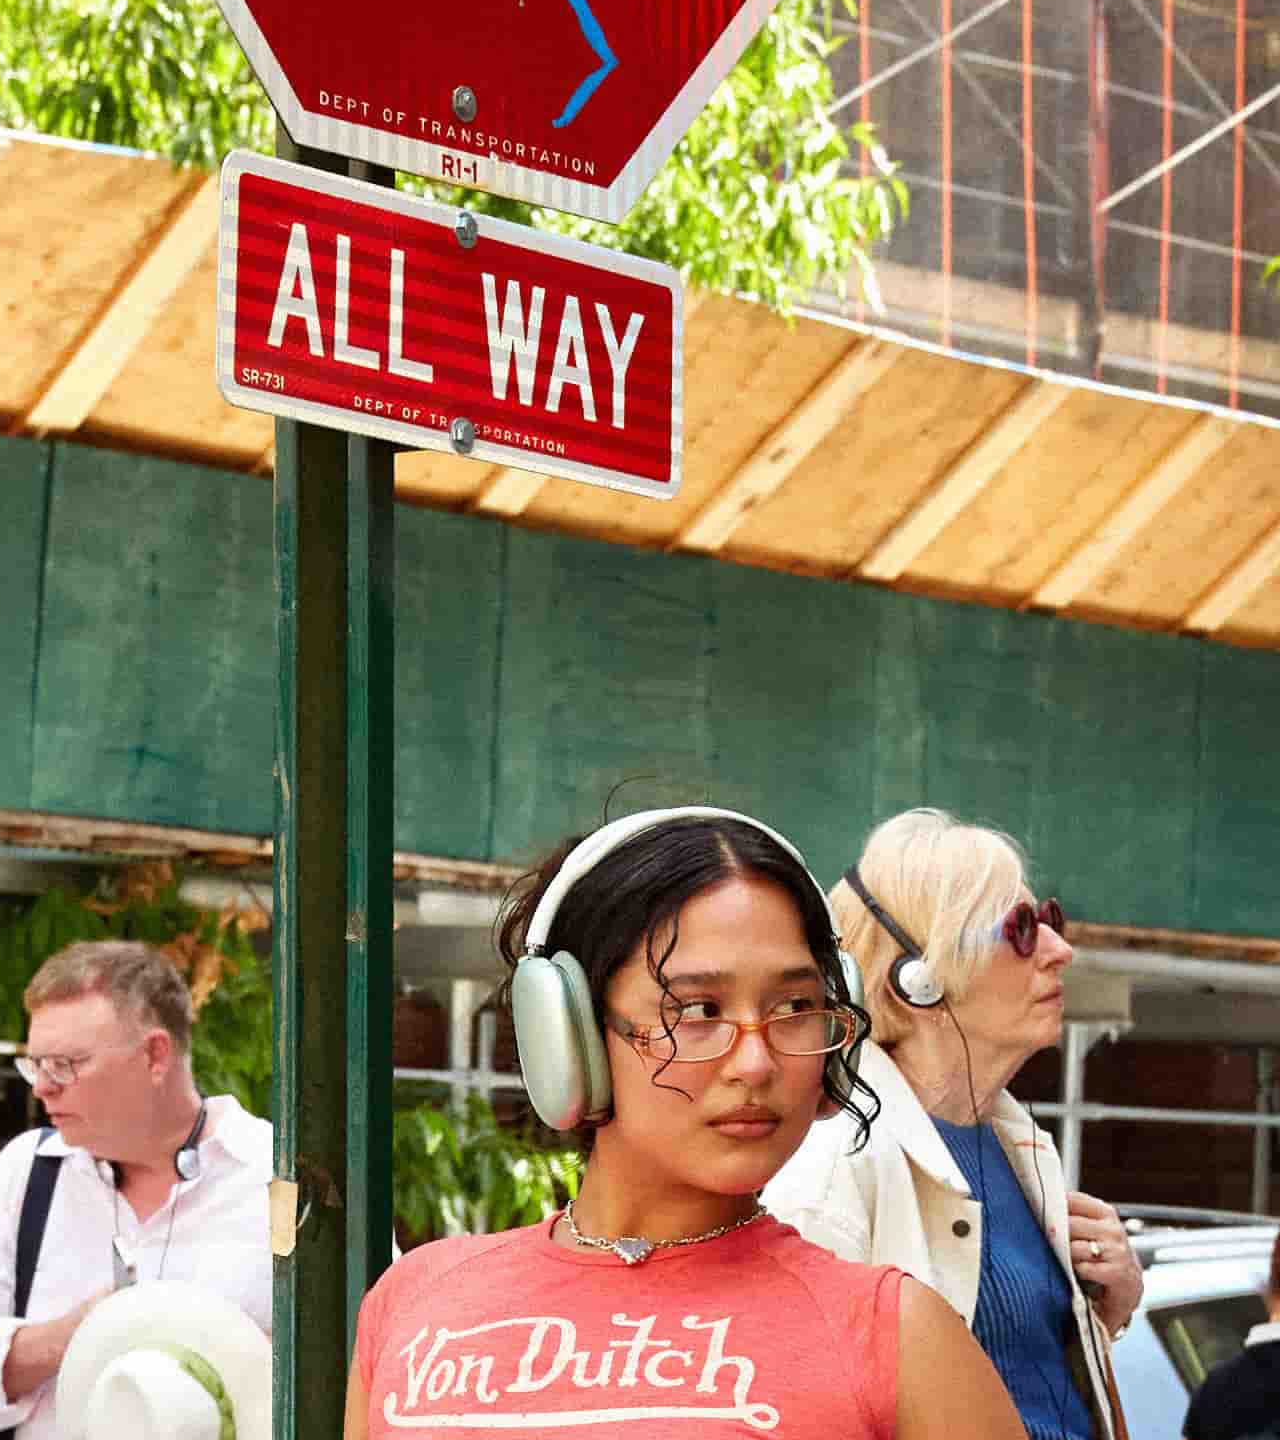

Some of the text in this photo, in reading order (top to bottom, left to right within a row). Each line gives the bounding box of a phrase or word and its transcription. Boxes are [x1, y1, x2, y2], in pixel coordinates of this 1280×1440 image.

[319, 90, 596, 176] DEPT OF TRANSPORTATION
[267, 223, 645, 429] ALL WAY
[241, 367, 285, 390] SR-731
[354, 396, 566, 455] DEPT OF TRSPORTATION
[399, 1312, 756, 1410] Von Dutch
